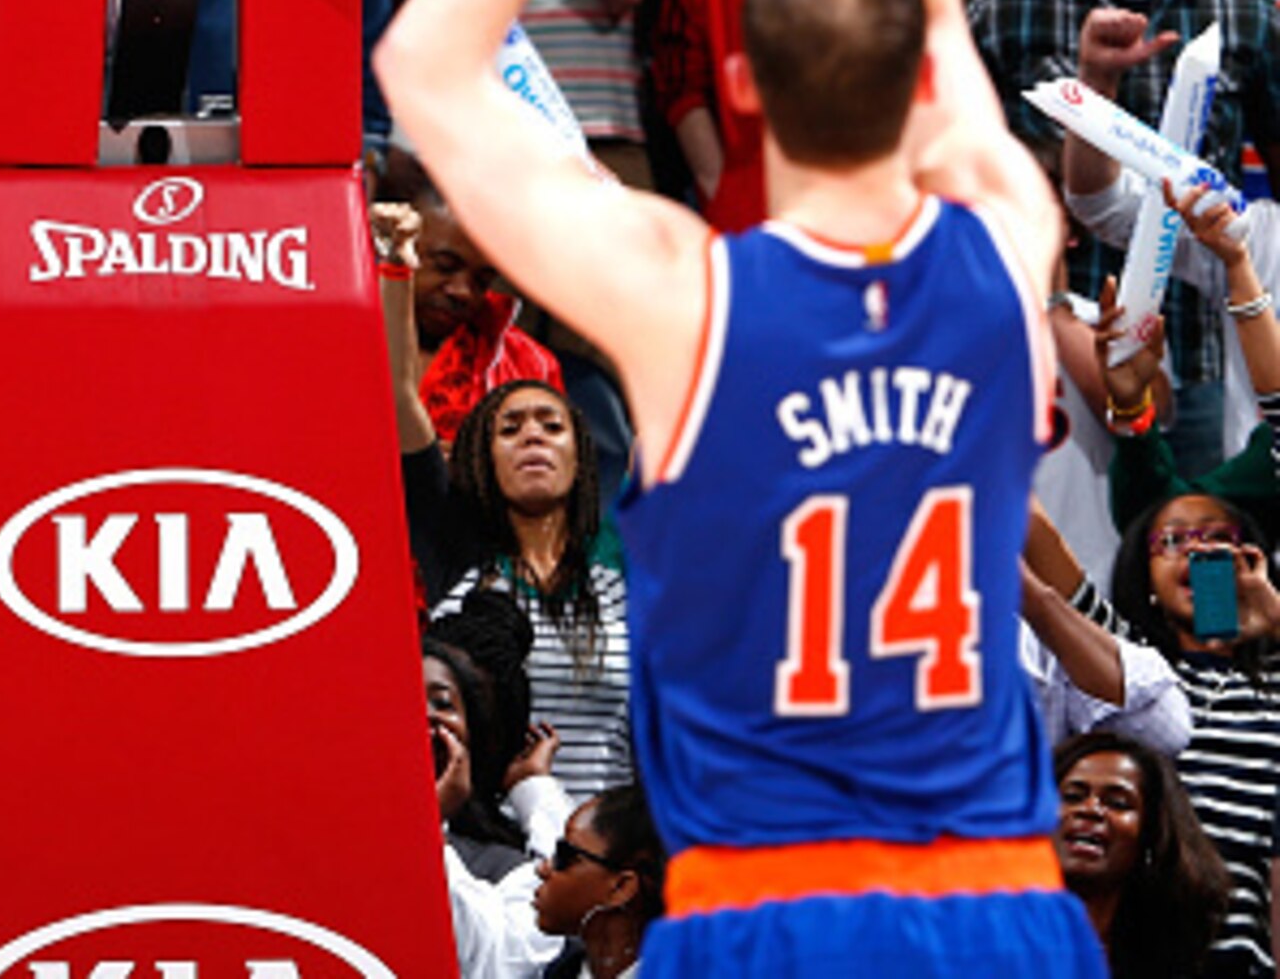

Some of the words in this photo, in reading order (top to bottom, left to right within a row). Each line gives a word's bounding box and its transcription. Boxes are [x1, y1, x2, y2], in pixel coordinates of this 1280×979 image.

[28, 218, 317, 292] SPALDING
[776, 366, 973, 469] SMITH
[50, 512, 299, 614] KIA
[775, 483, 983, 717] 14
